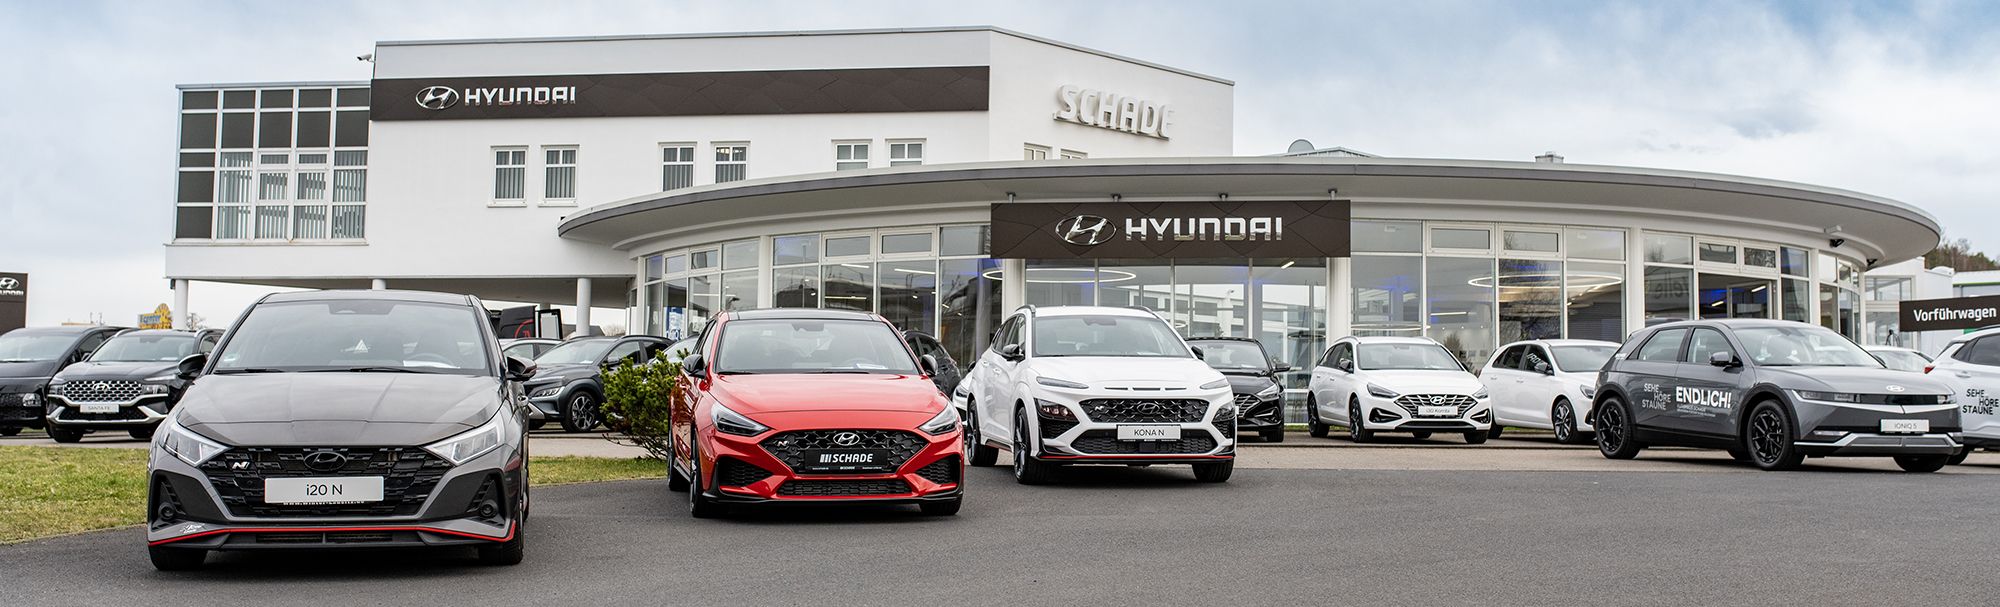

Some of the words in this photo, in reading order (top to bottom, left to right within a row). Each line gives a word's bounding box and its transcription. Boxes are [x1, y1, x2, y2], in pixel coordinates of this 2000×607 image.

[464, 86, 576, 106] HYUNDAI
[1056, 84, 1175, 139] SCHADE
[1126, 217, 1283, 241] HYUNDAI
[1913, 307, 1997, 321] Vorführwagen
[1643, 383, 1660, 393] SEHE
[1966, 388, 1985, 398] SEHE
[1675, 386, 1732, 409] ENDLICH!
[1642, 400, 1667, 411] STAUNE
[1962, 404, 1994, 416] STAUNE
[1895, 422, 1912, 430] IONIQ
[832, 453, 874, 463] SCHADE
[306, 484, 328, 496] i20
[332, 484, 343, 495] N
